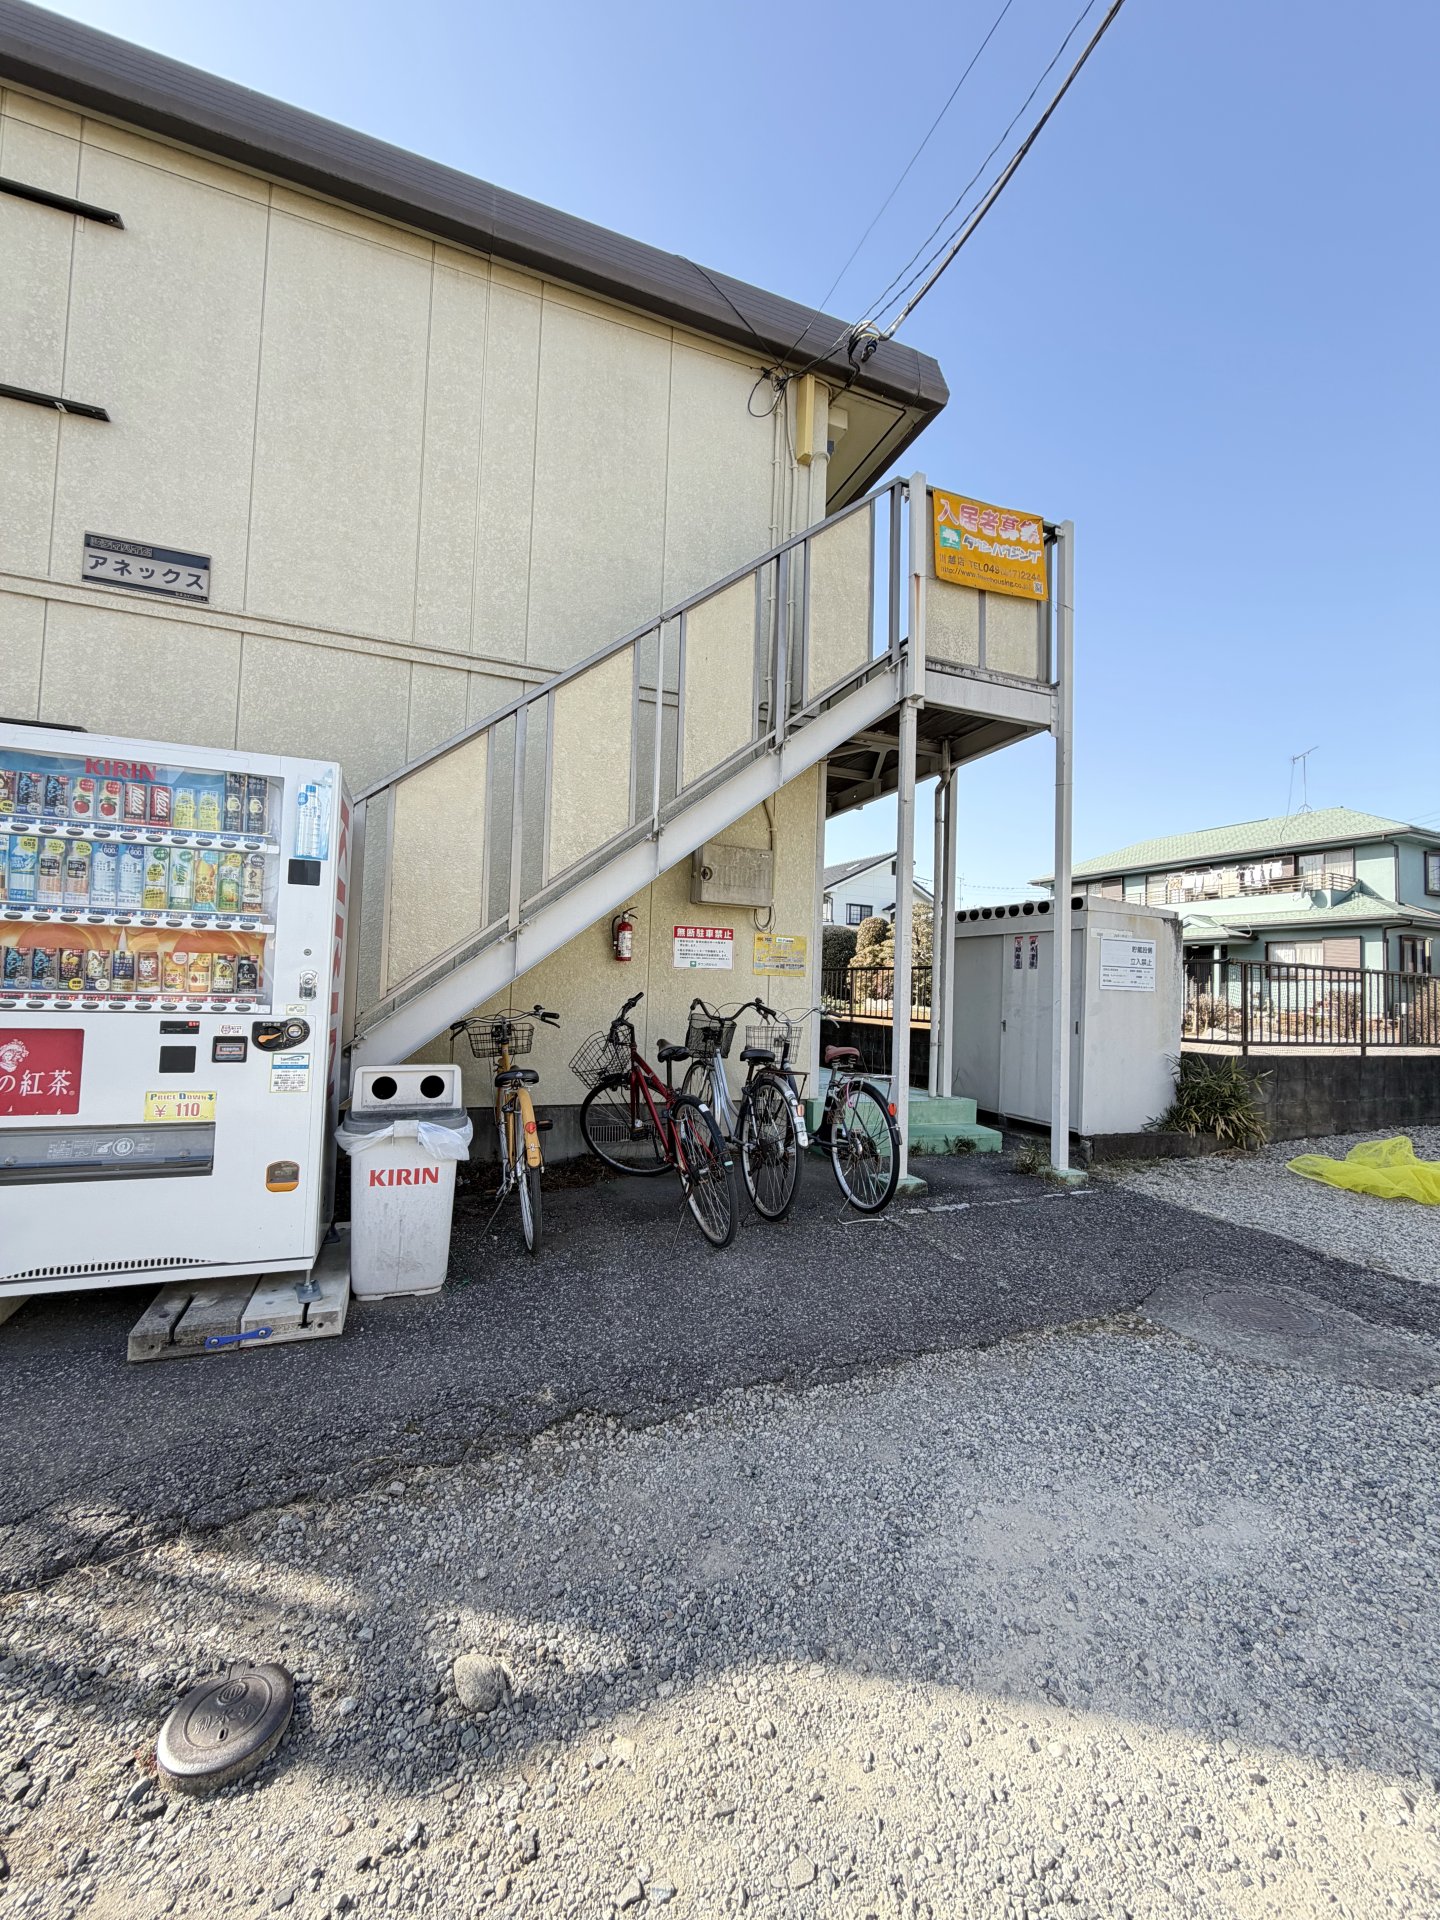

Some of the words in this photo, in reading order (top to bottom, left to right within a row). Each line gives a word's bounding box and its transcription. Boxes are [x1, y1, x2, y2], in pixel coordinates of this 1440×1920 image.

[88, 554, 205, 591] アネックス
[85, 758, 157, 781] KIRIN
[676, 928, 732, 939] 無断駐車禁止
[1130, 958, 1153, 966] 立入禁止
[369, 1166, 440, 1188] KIRIN
